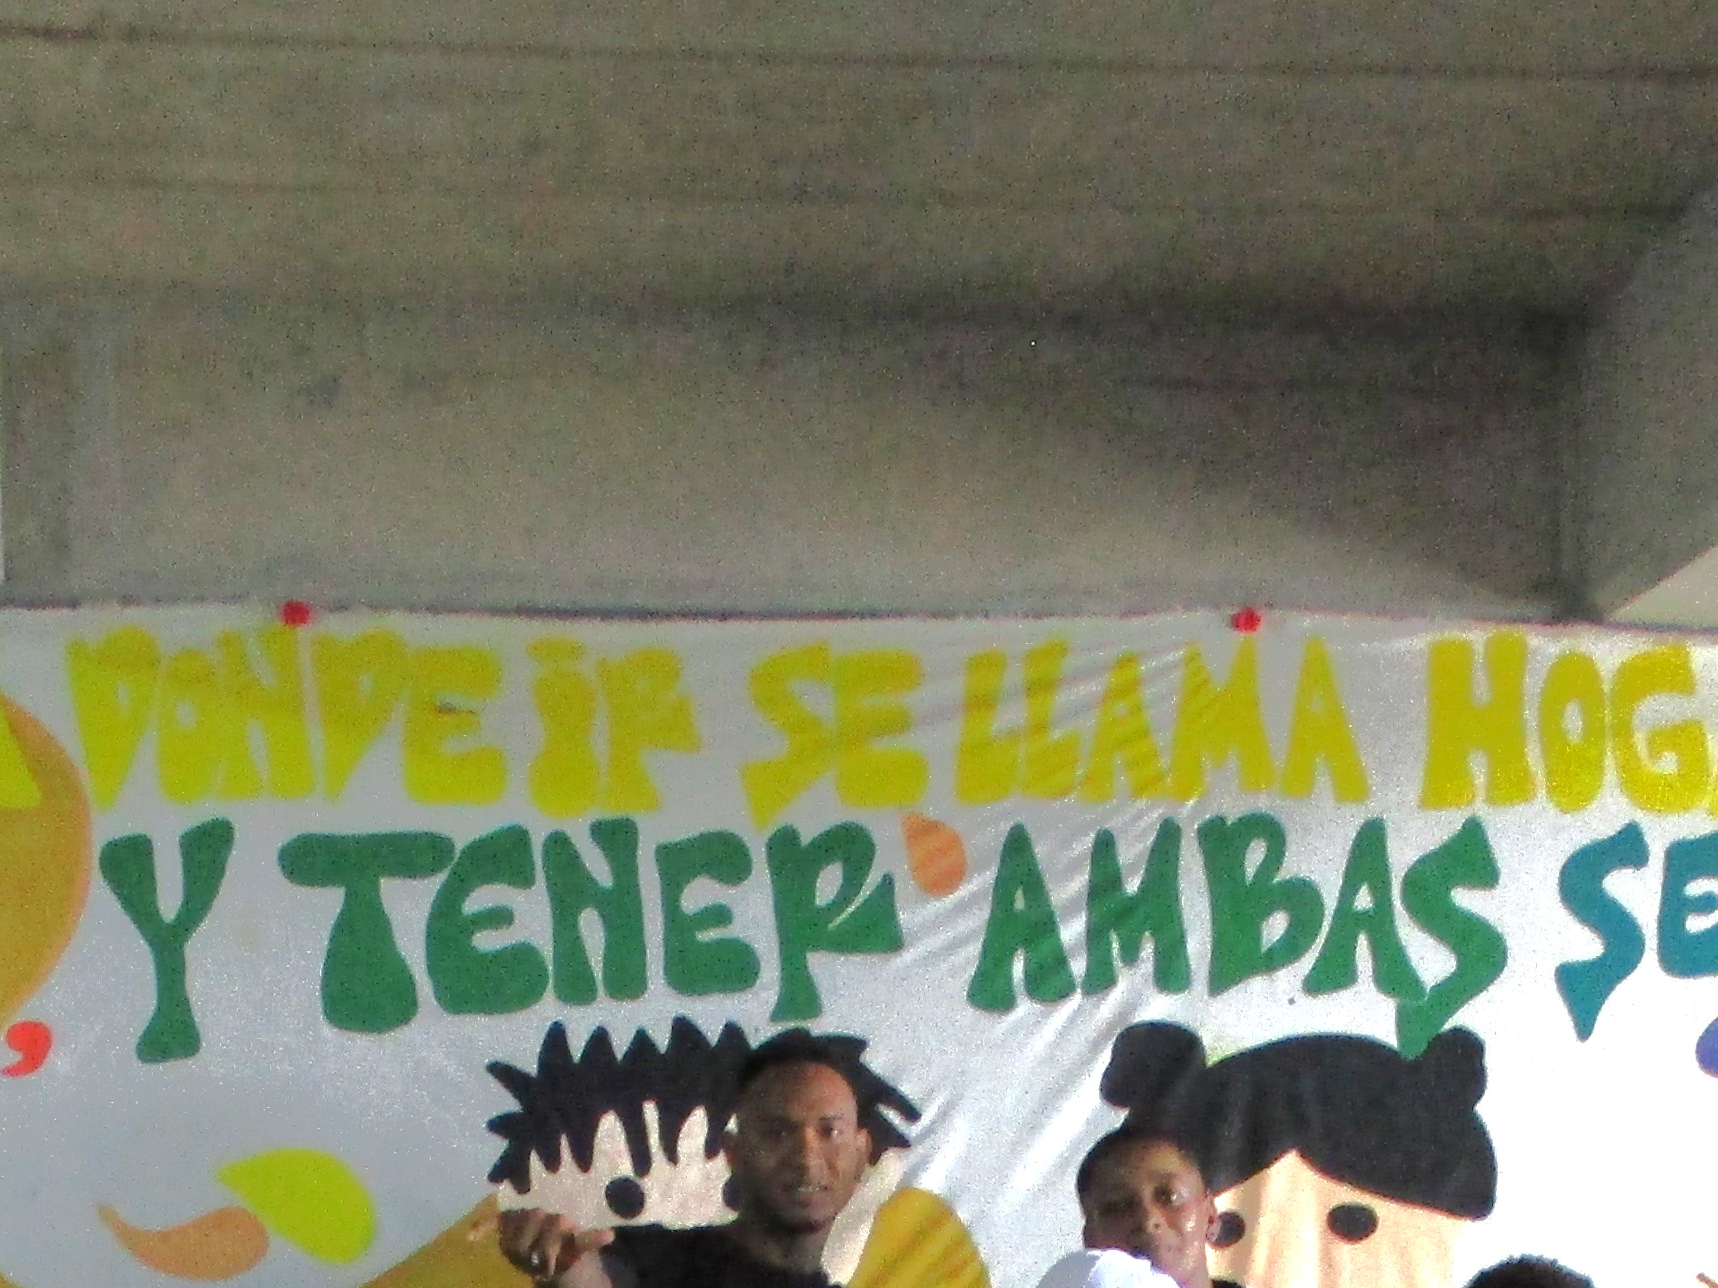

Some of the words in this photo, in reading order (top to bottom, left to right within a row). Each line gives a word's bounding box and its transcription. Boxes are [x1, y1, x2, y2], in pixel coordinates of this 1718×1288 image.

[68, 624, 508, 812] DONDE
[740, 639, 929, 829] SE
[954, 626, 1370, 806] LLAMA
[99, 817, 236, 1063] Y
[278, 814, 904, 1033] TENER
[966, 812, 1509, 1060] AMBAS
